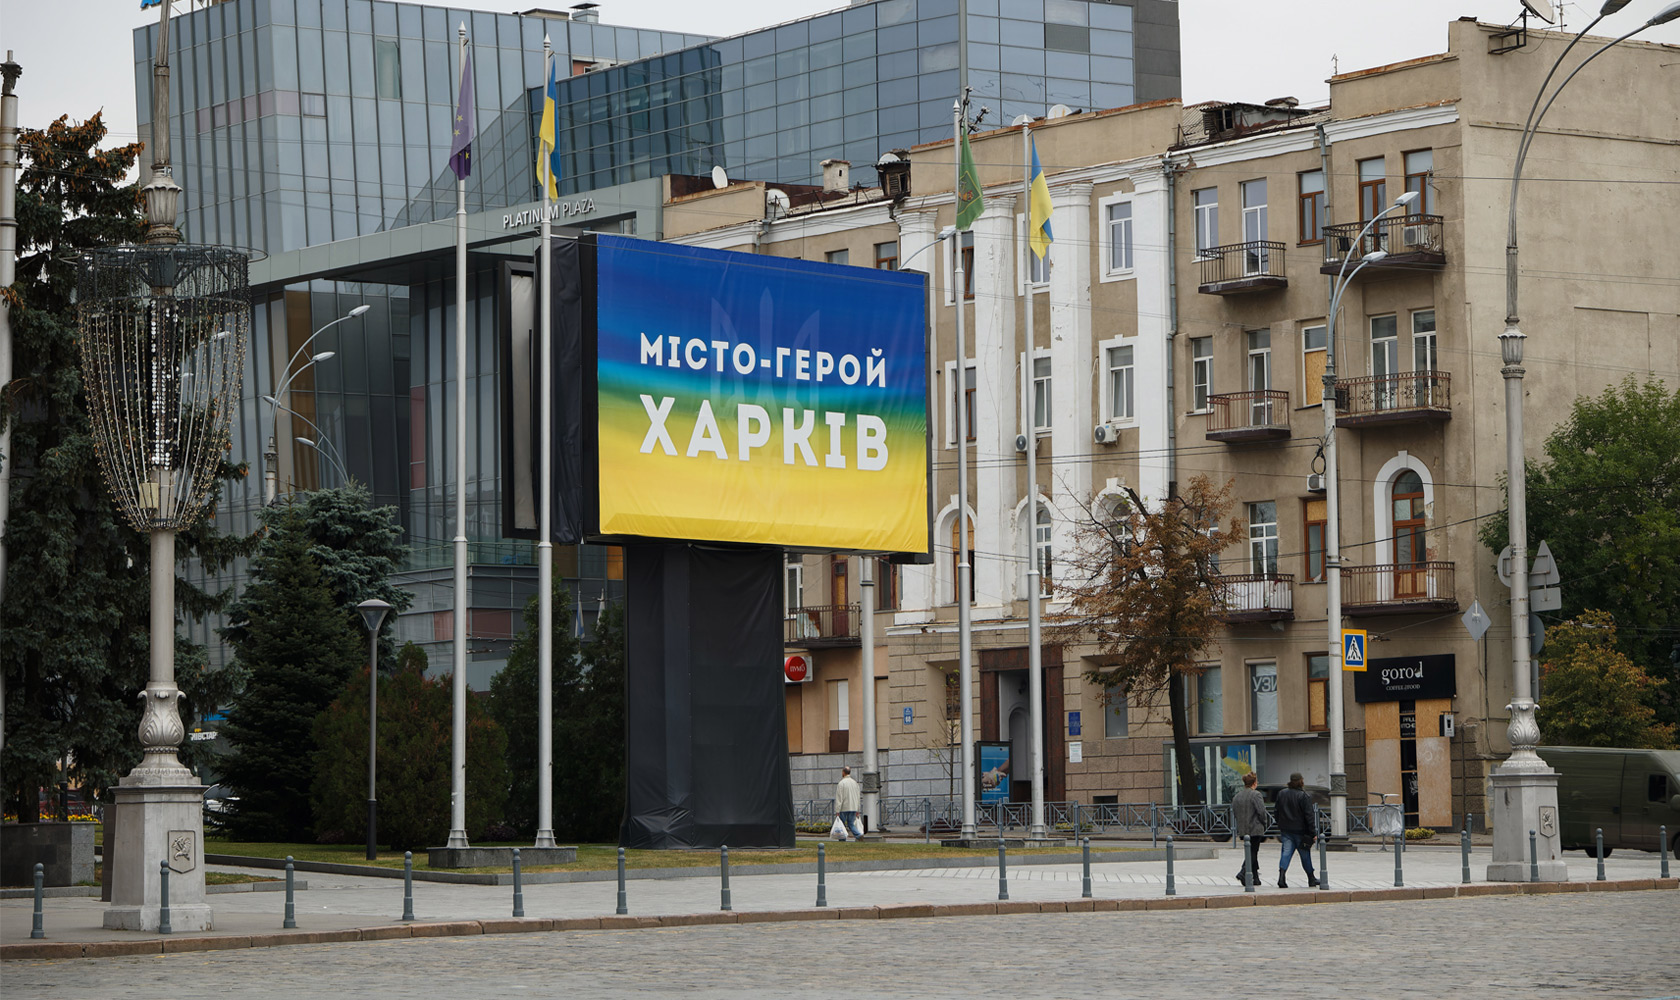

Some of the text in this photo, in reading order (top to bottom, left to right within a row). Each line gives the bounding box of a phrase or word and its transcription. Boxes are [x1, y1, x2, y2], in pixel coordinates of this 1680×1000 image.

[562, 198, 596, 217] PLAZA
[640, 332, 886, 388] МІСТО-ГЕРОЙ
[639, 394, 889, 471] ХАРКІВ
[1381, 661, 1424, 685] gorod
